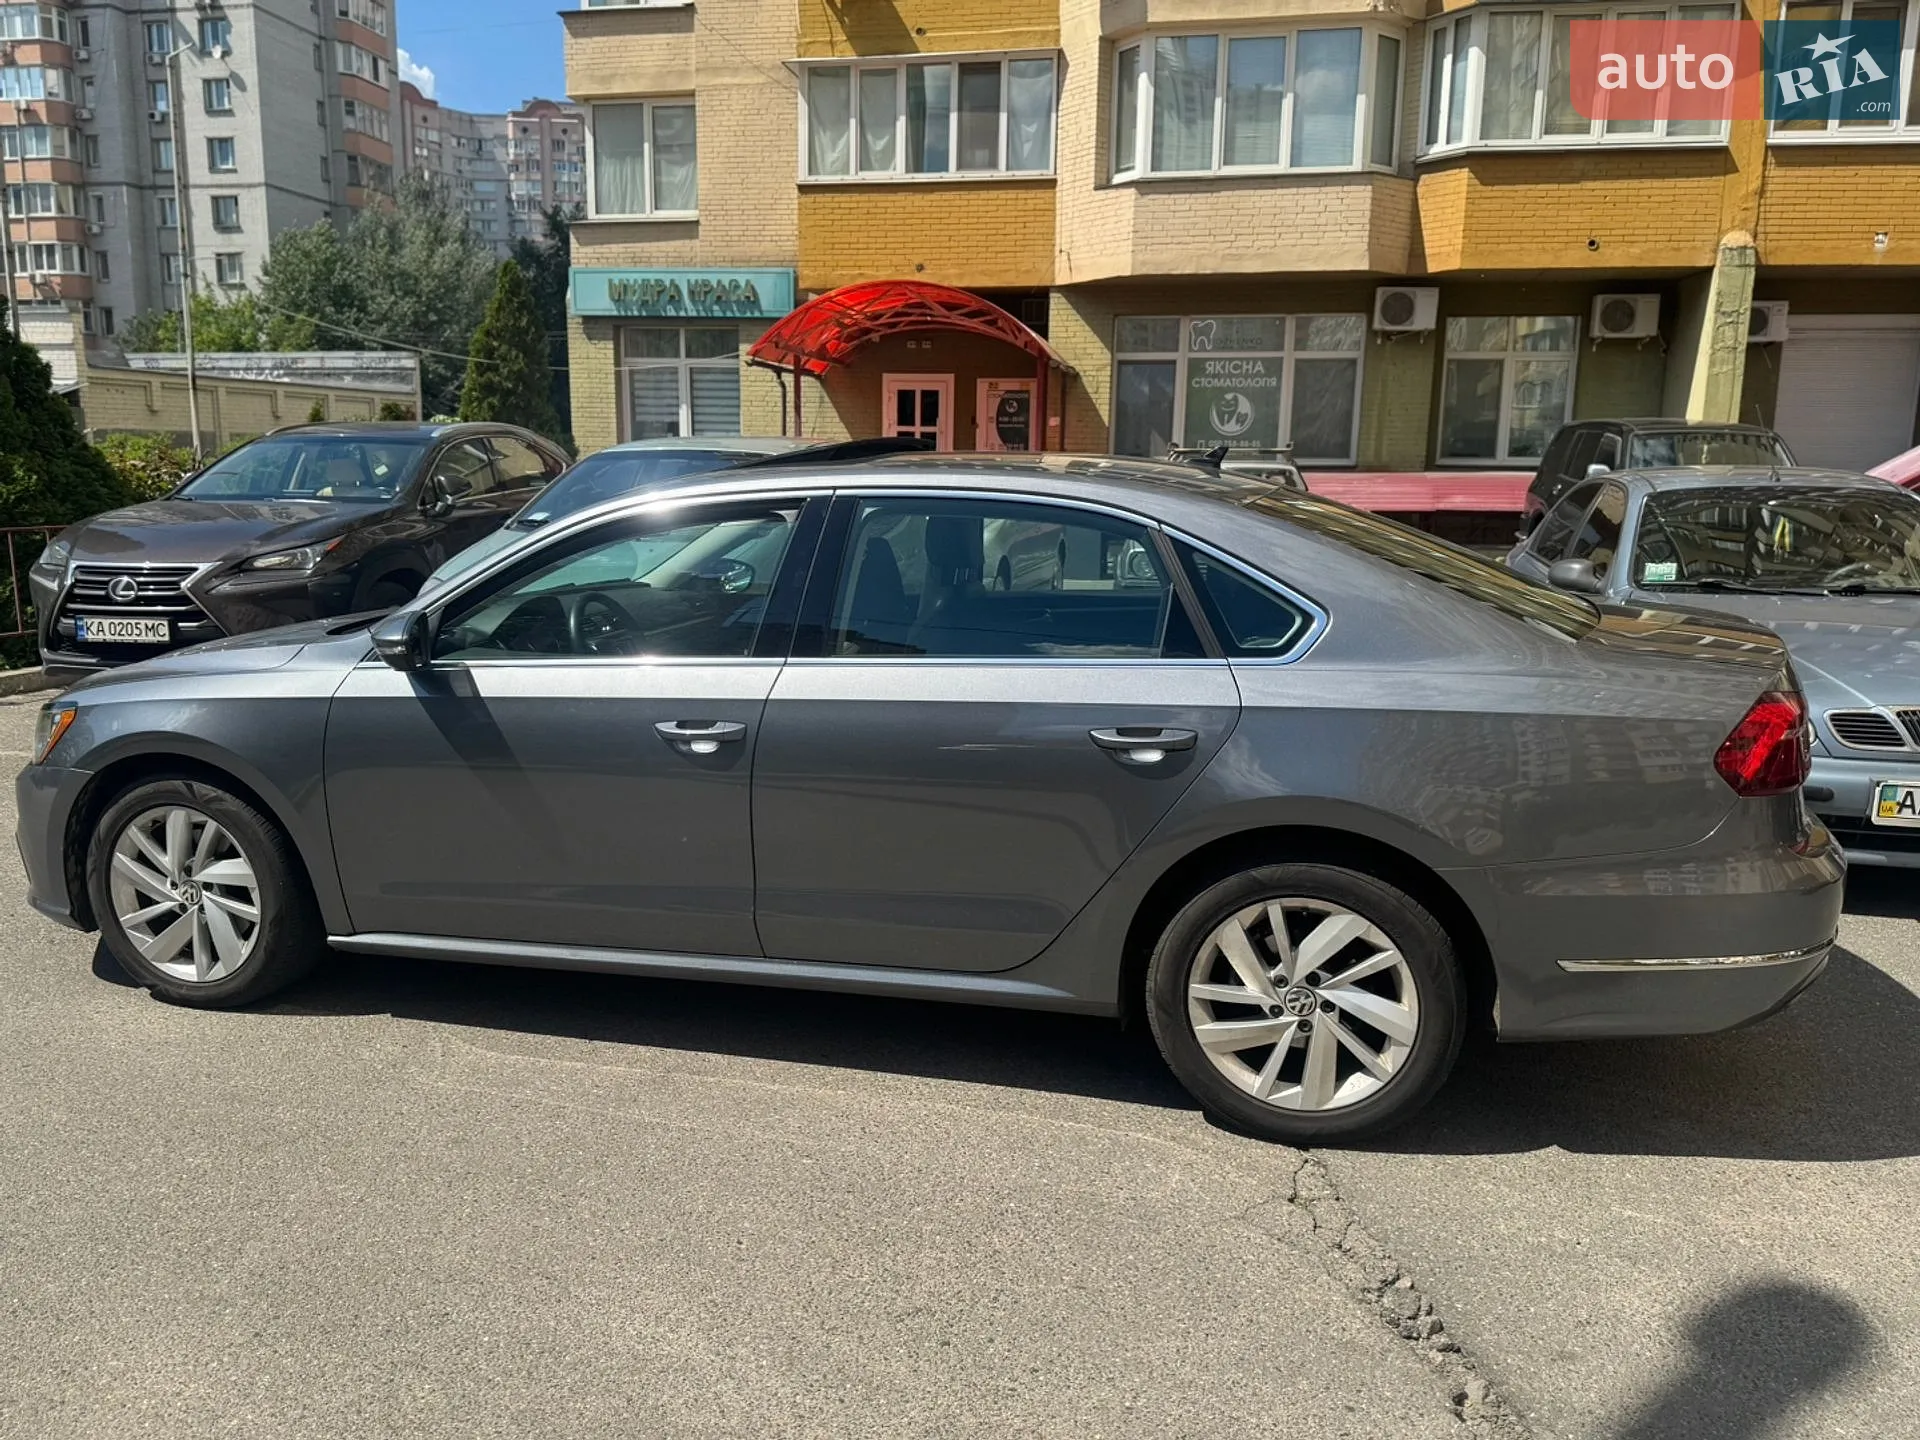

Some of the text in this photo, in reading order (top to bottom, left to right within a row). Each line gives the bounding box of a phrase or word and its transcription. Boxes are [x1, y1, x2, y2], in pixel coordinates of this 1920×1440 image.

[1205, 360, 1265, 375] ЯКІСНА
[86, 620, 106, 637] KA
[108, 621, 143, 637] 0205
